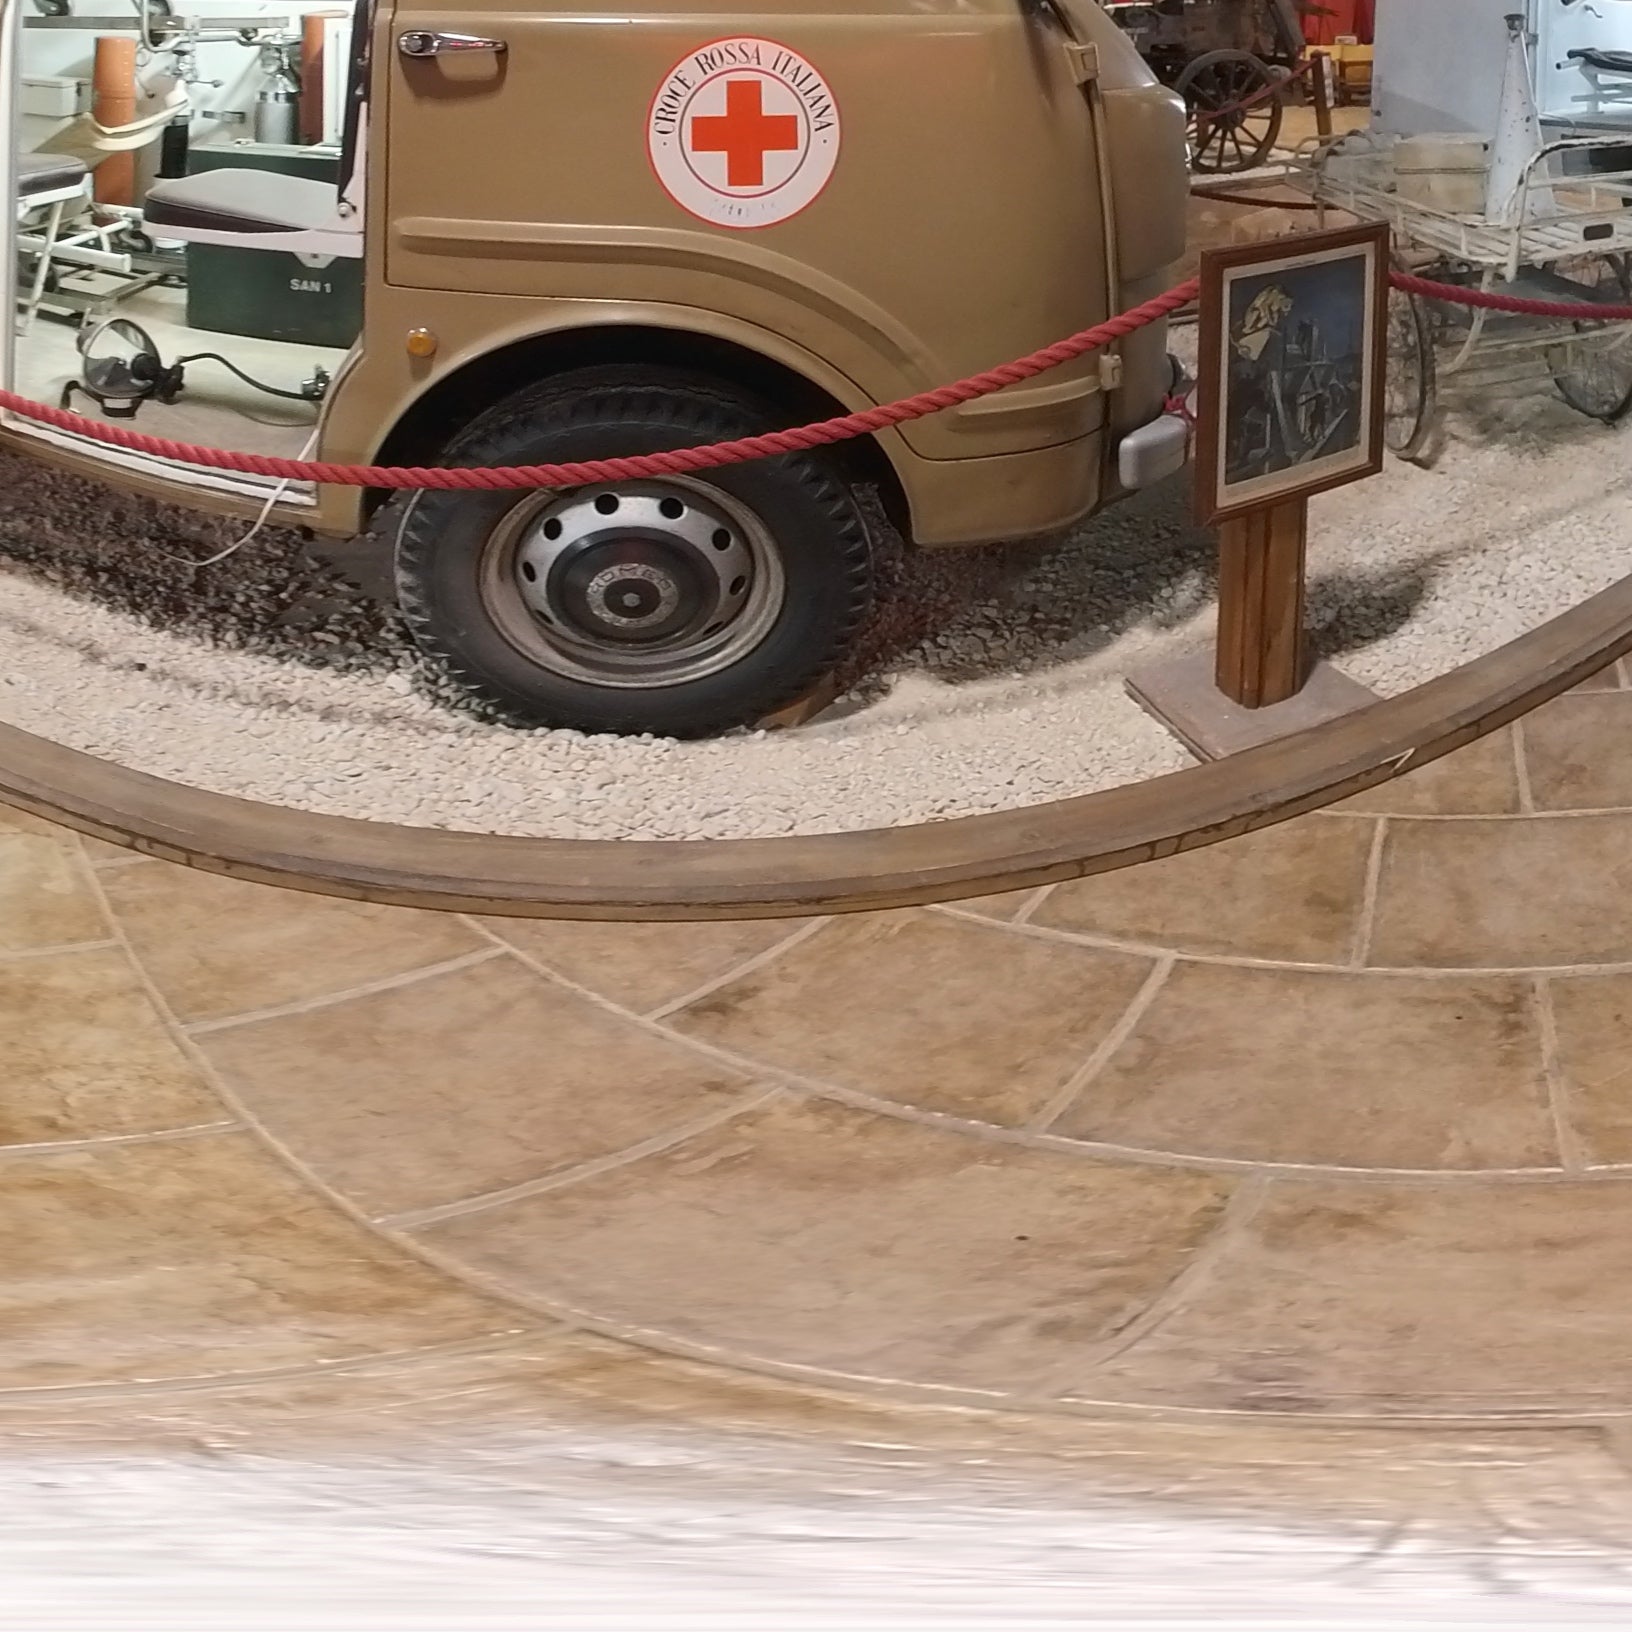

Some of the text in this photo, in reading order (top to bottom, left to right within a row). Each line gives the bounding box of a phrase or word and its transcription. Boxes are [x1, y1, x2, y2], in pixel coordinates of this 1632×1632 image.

[653, 42, 835, 135] CROCE ROSSA ITALIANA
[290, 278, 332, 294] SAN 1
